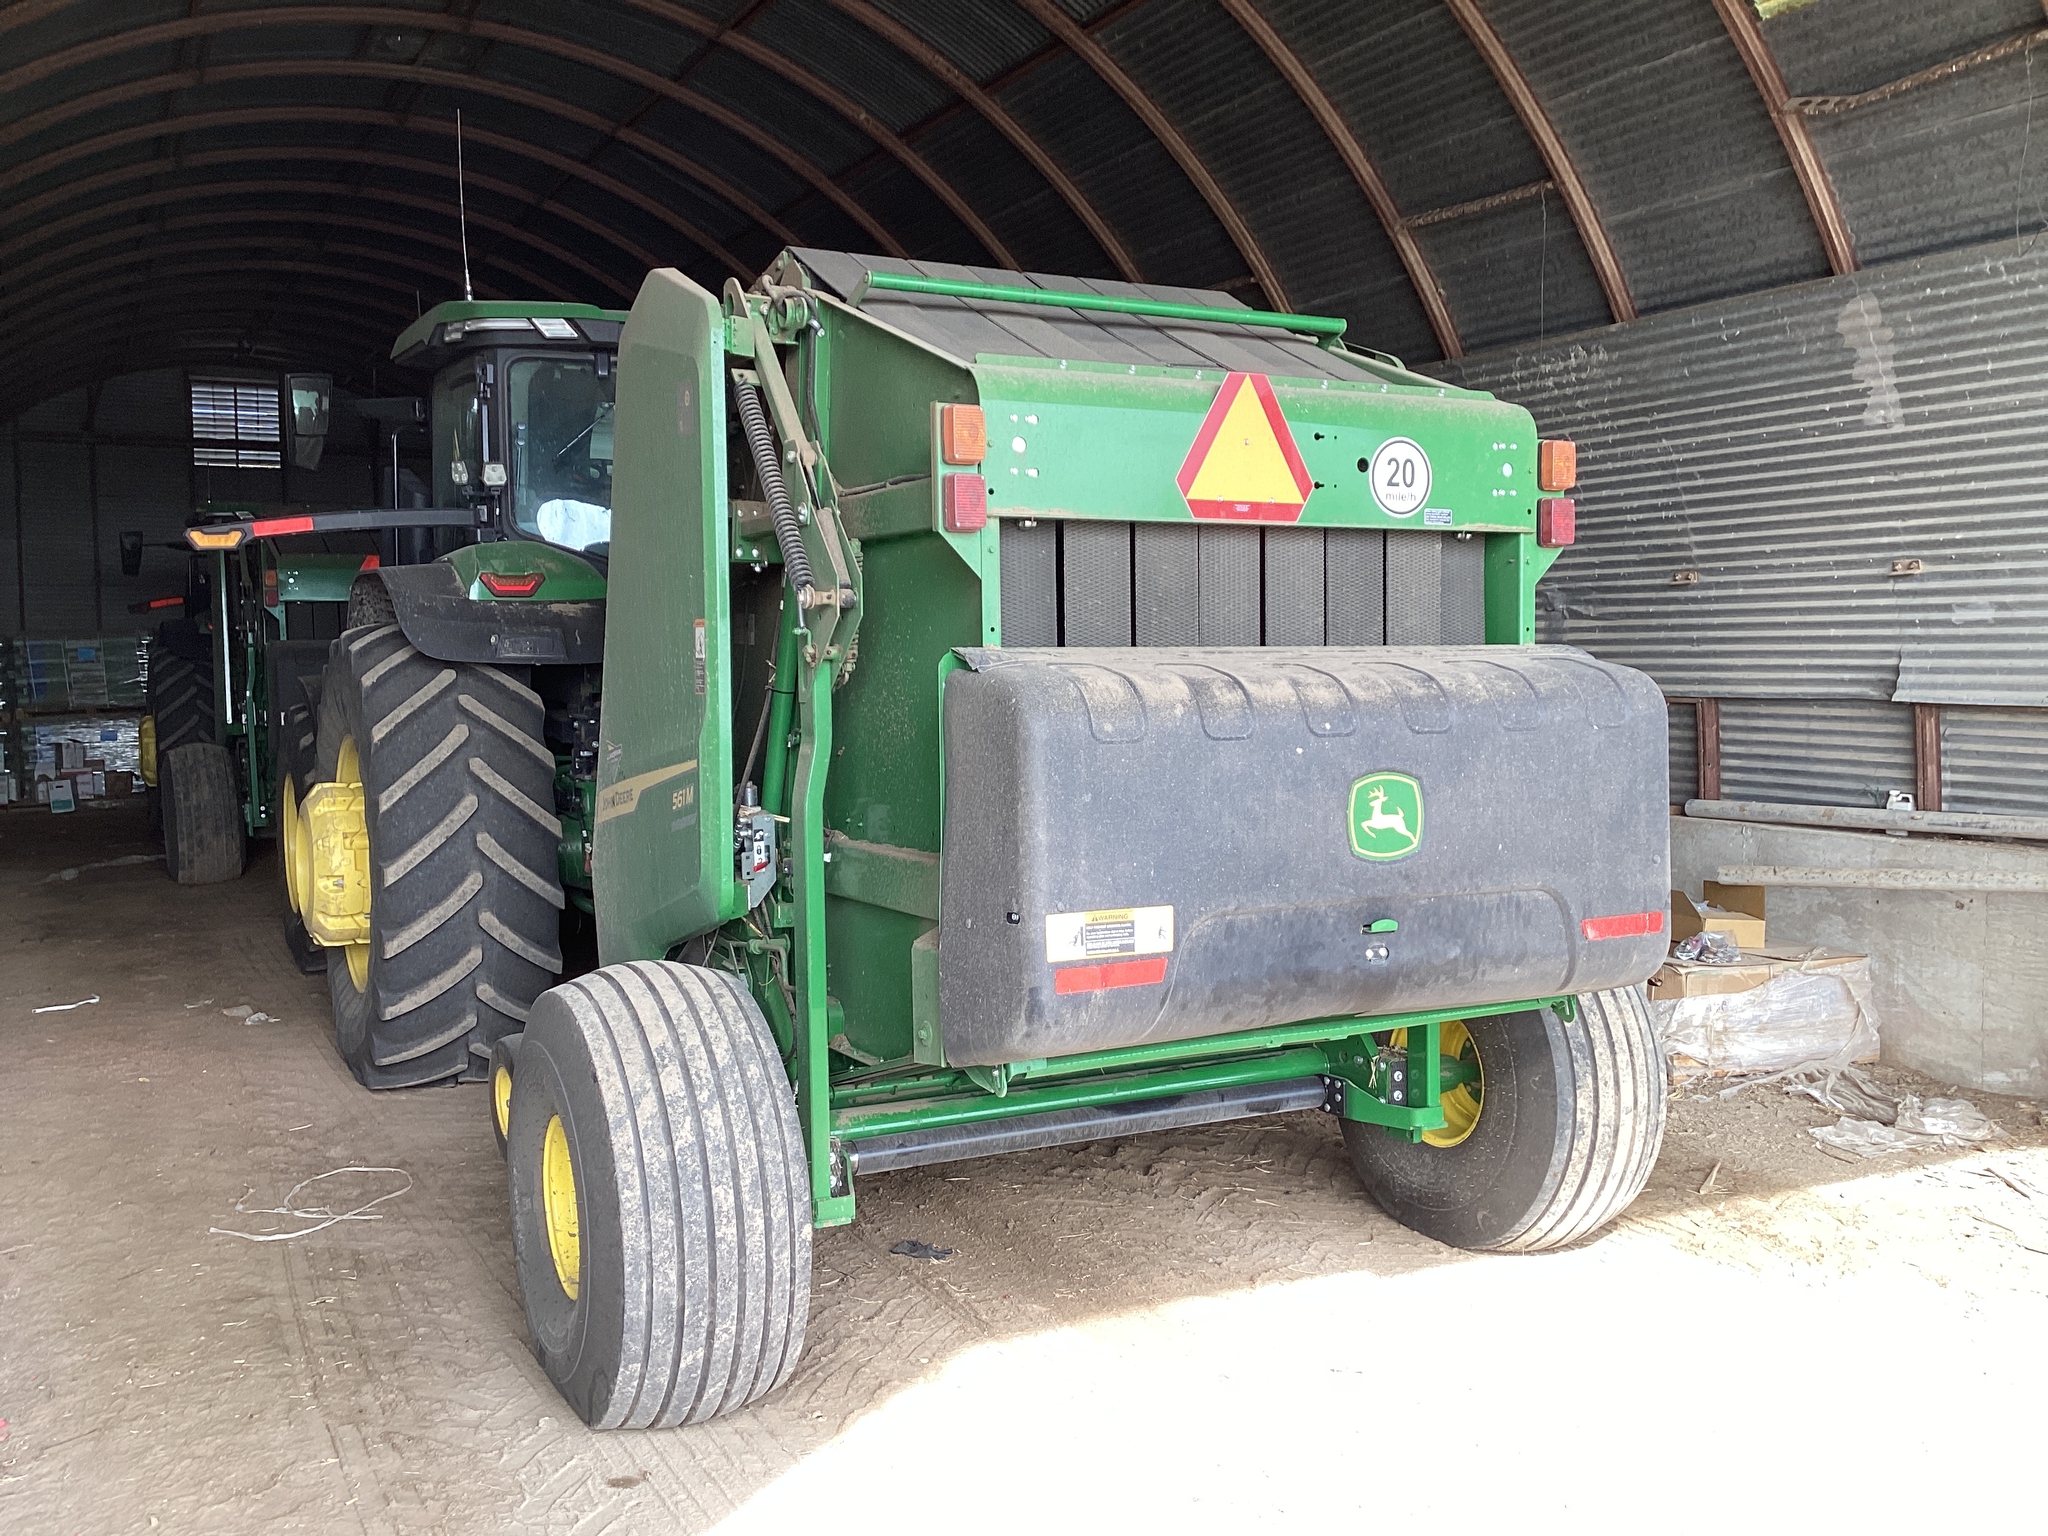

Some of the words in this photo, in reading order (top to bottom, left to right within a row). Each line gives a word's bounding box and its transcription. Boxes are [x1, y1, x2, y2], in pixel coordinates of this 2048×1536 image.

[1386, 457, 1415, 488] 20
[1385, 492, 1417, 502] mile/h
[615, 788, 634, 806] DEERE
[672, 784, 694, 811] 561M
[1098, 913, 1129, 921] WARNING
